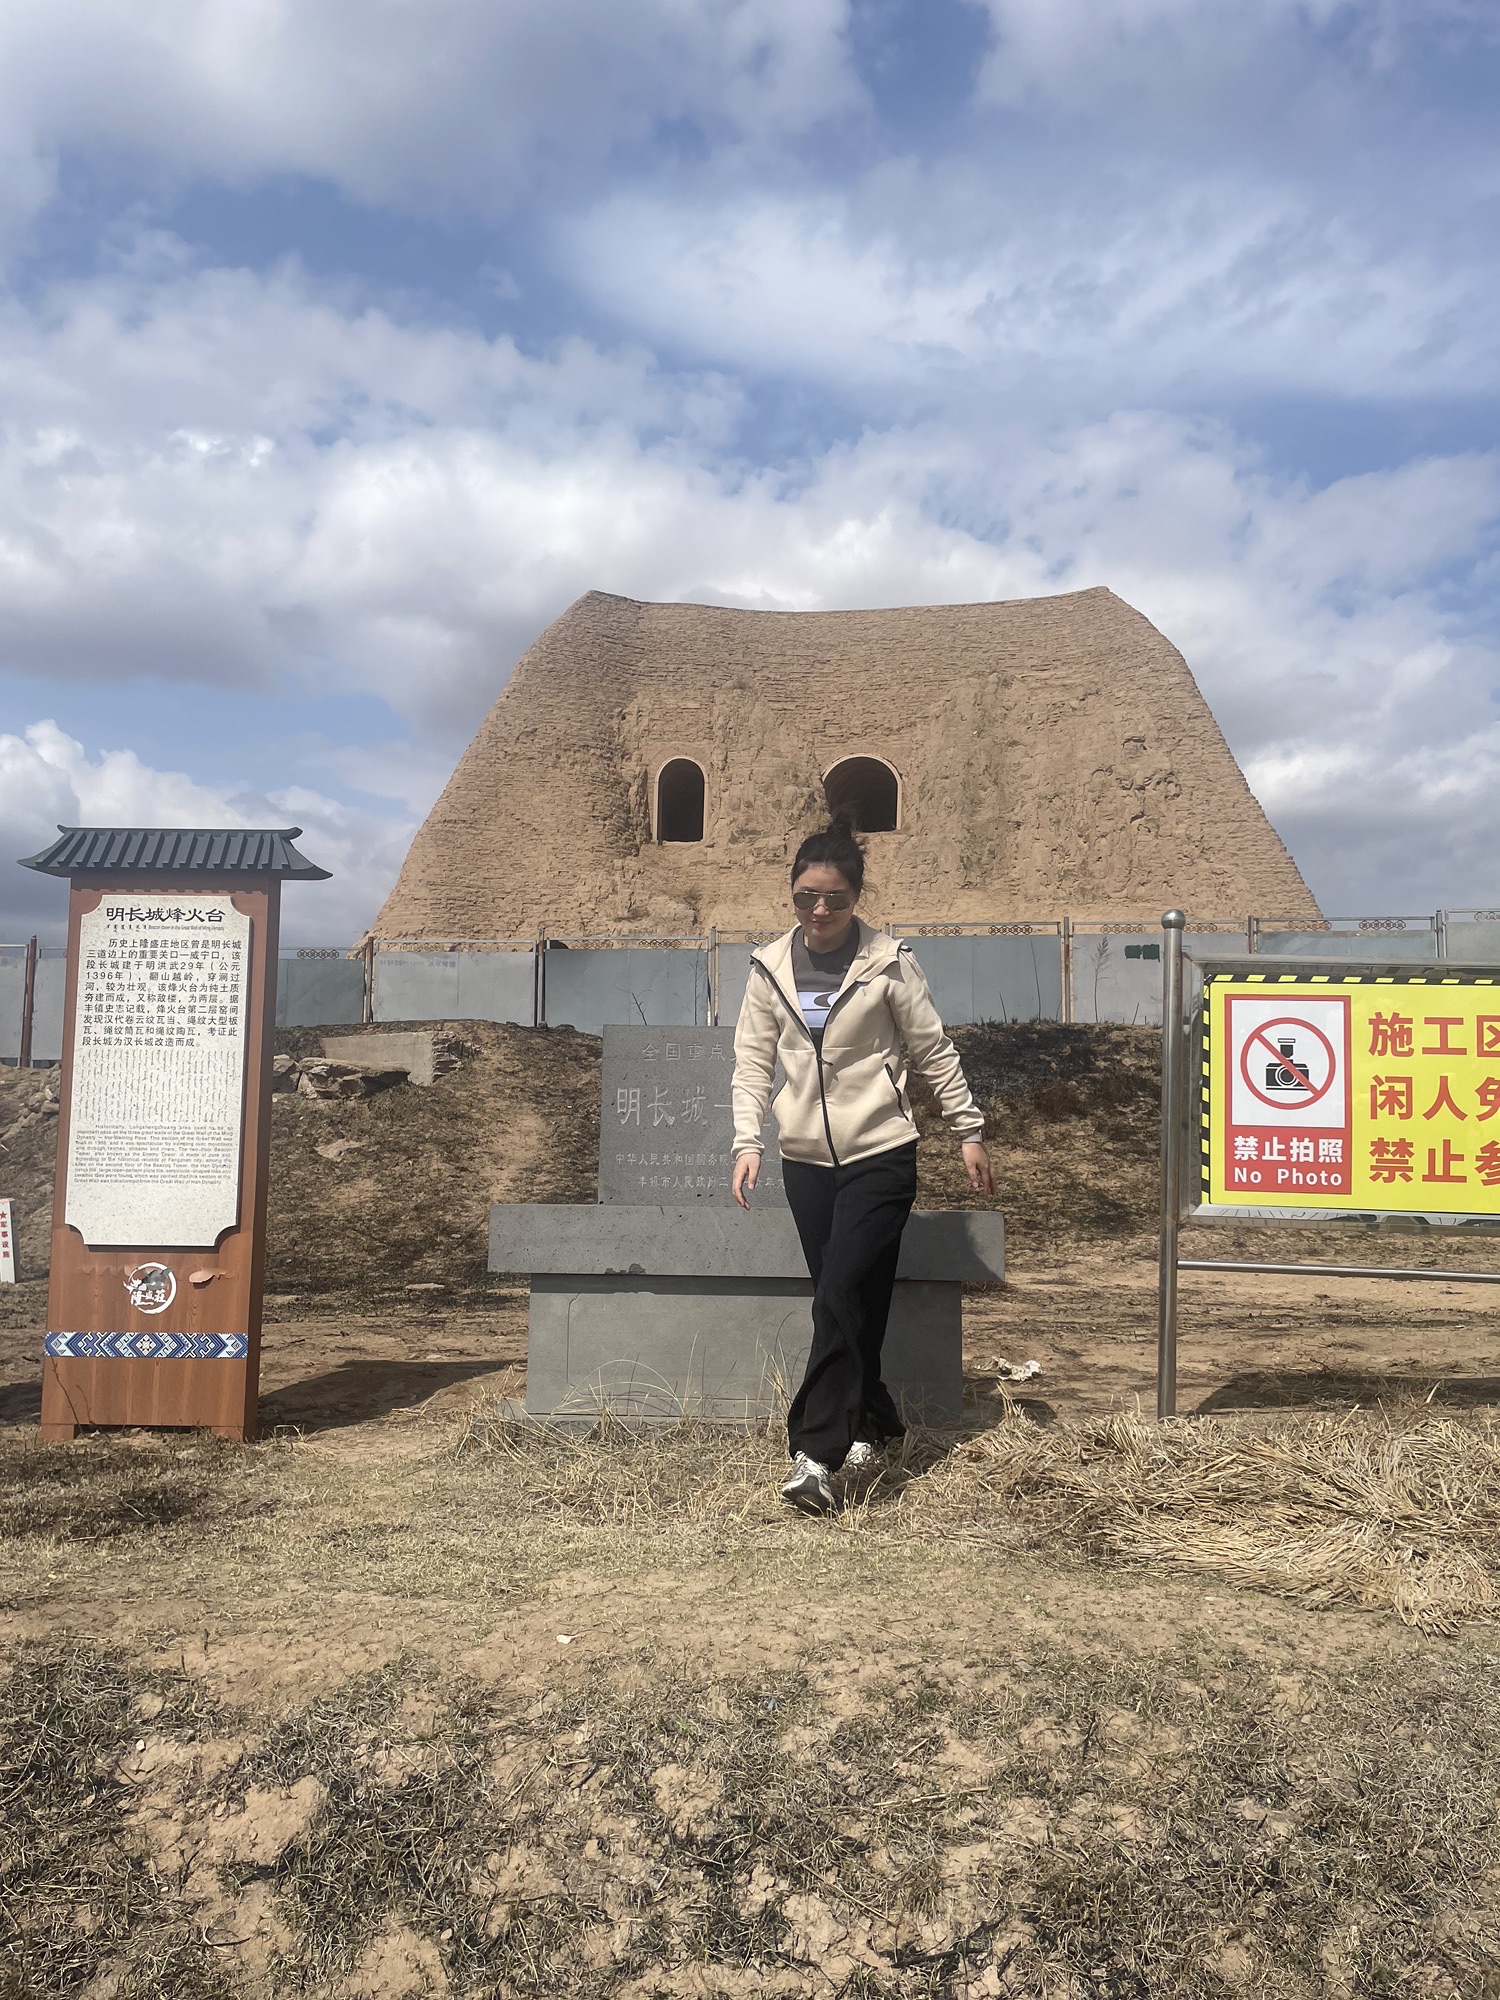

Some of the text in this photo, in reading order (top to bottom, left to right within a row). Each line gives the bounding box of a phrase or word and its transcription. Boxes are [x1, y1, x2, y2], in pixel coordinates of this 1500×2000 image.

[107, 908, 225, 922] 明长城烽火台
[109, 939, 241, 949] 历史上隆盛庄地区曾是明长城
[82, 1037, 201, 1047] 段长城为汉长城改造而成。
[643, 1043, 737, 1061] 全国重点
[1234, 1136, 1343, 1163] 禁止拍照
[1234, 1167, 1342, 1186] No Photo
